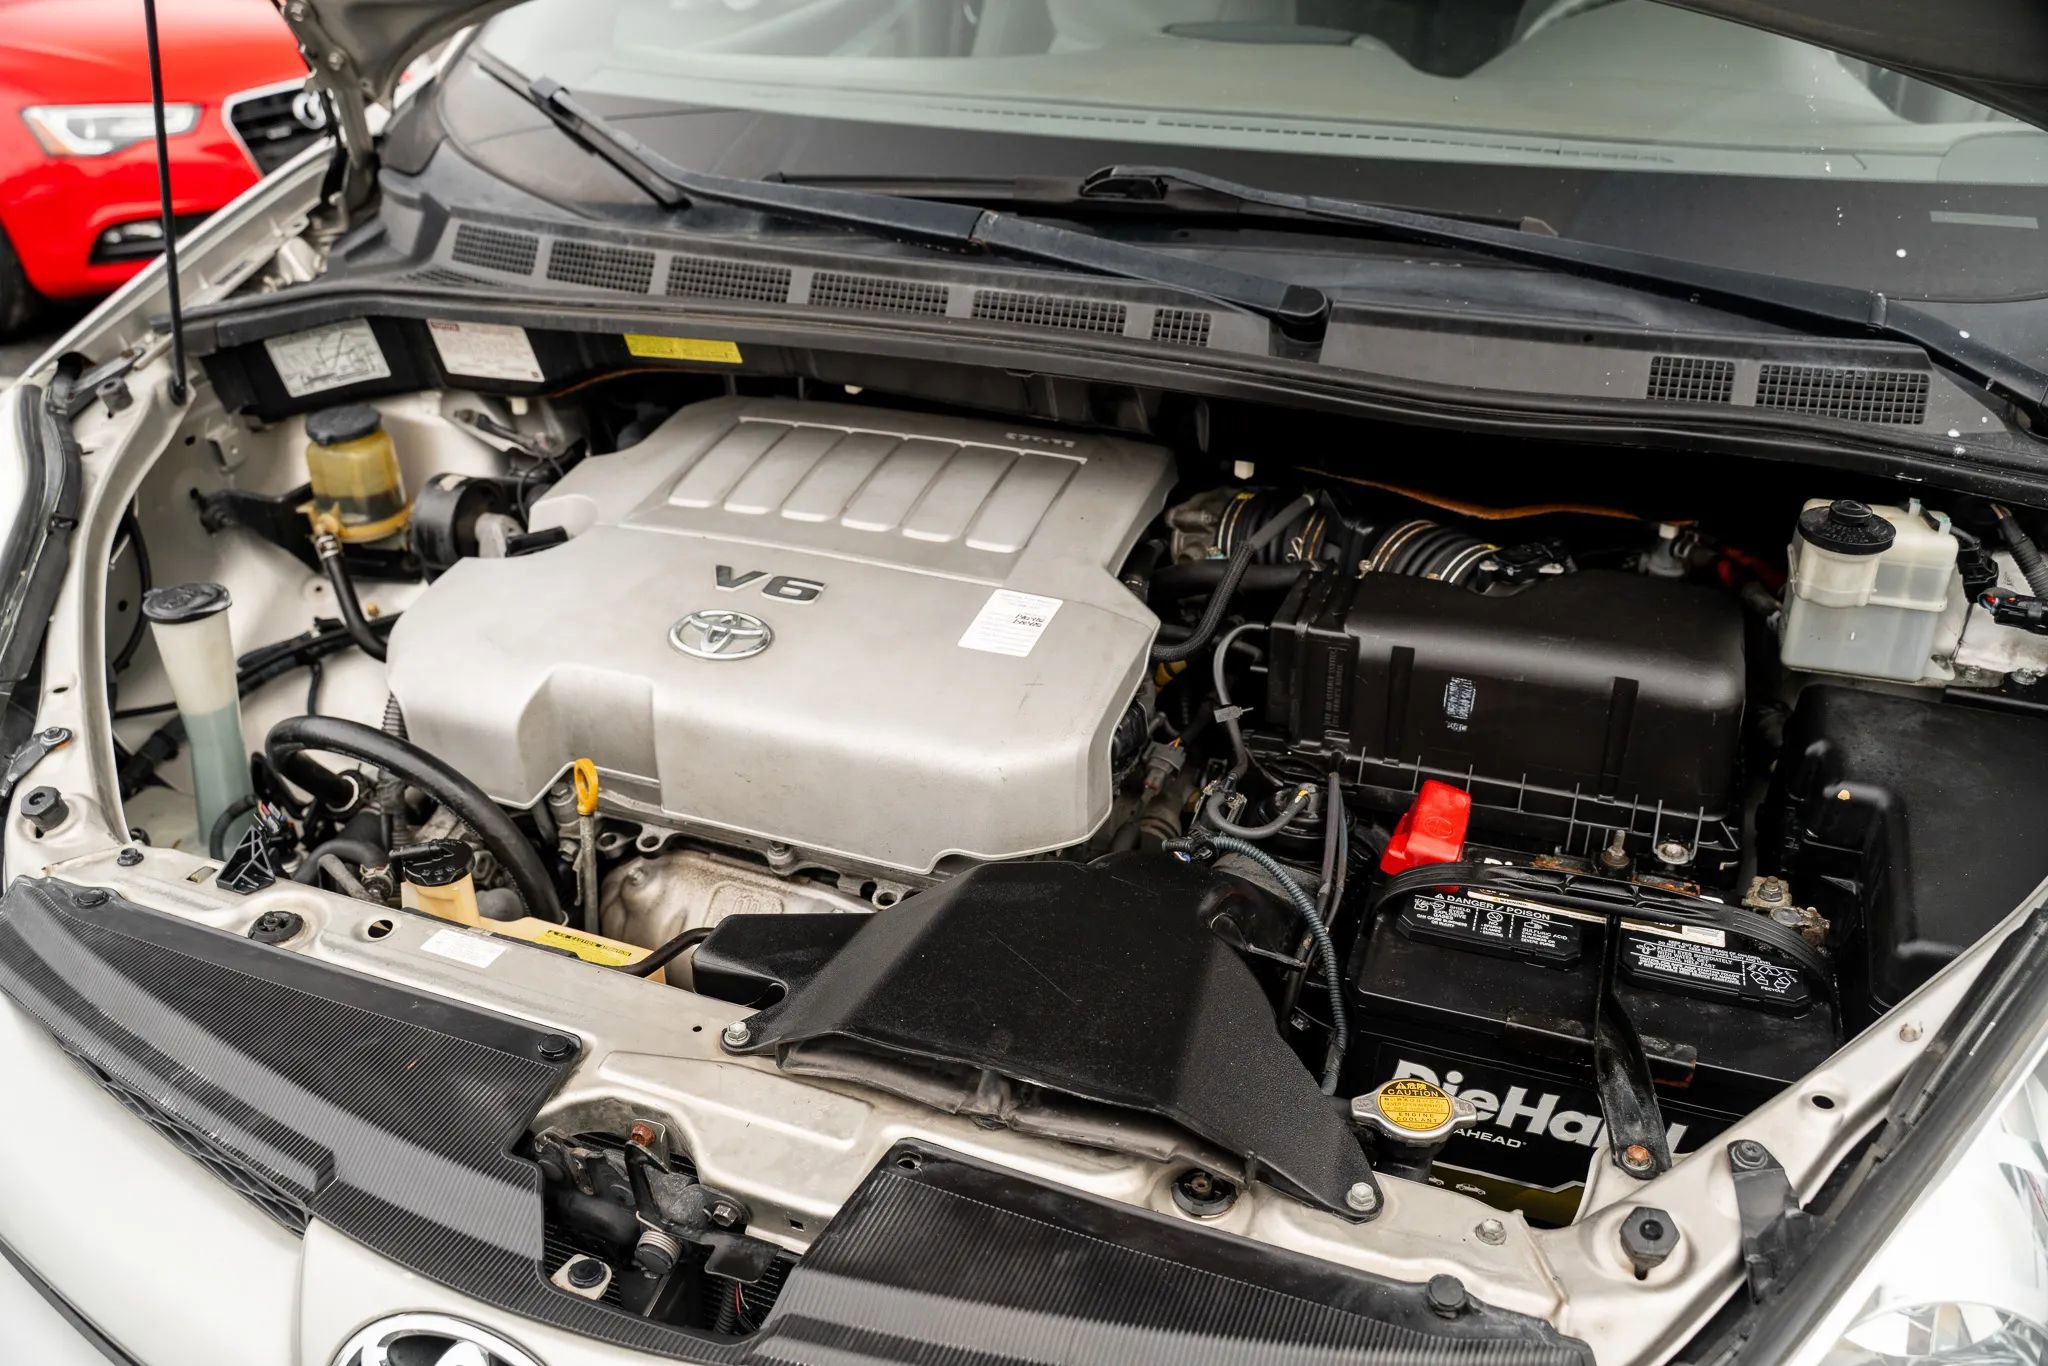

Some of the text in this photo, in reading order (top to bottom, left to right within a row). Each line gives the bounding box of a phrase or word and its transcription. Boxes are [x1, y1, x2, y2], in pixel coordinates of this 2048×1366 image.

[715, 565, 824, 604] V6
[1446, 895, 1495, 911] DANGER
[1506, 906, 1551, 921] POISON
[1522, 927, 1551, 937] SULFURIC
[1388, 1089, 1439, 1097] CAUTION
